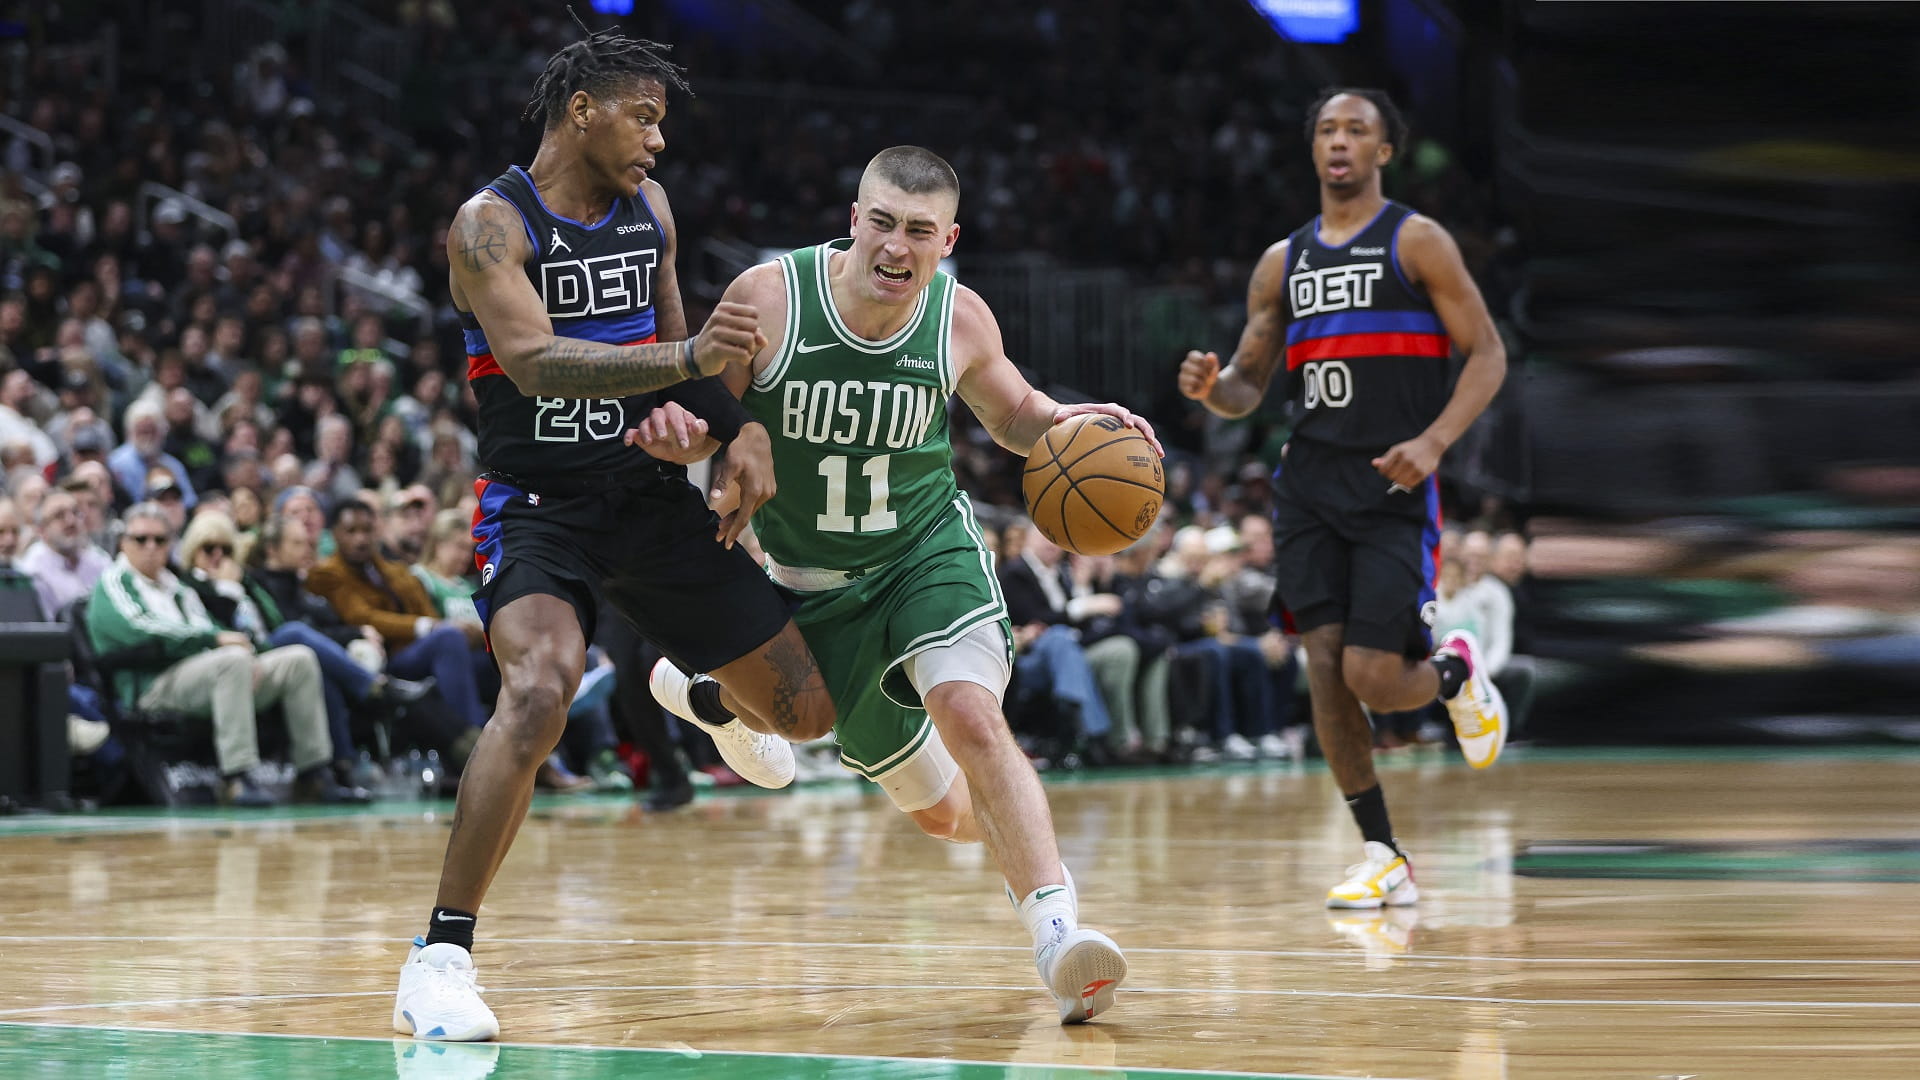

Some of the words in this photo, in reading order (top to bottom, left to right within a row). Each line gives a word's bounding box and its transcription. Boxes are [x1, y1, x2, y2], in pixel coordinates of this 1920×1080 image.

[541, 249, 656, 318] DET
[1289, 263, 1383, 318] DET
[896, 354, 935, 370] Amica
[1303, 361, 1353, 409] 00
[534, 395, 625, 442] 25
[782, 380, 938, 448] BOSTON
[816, 454, 898, 533] 11
